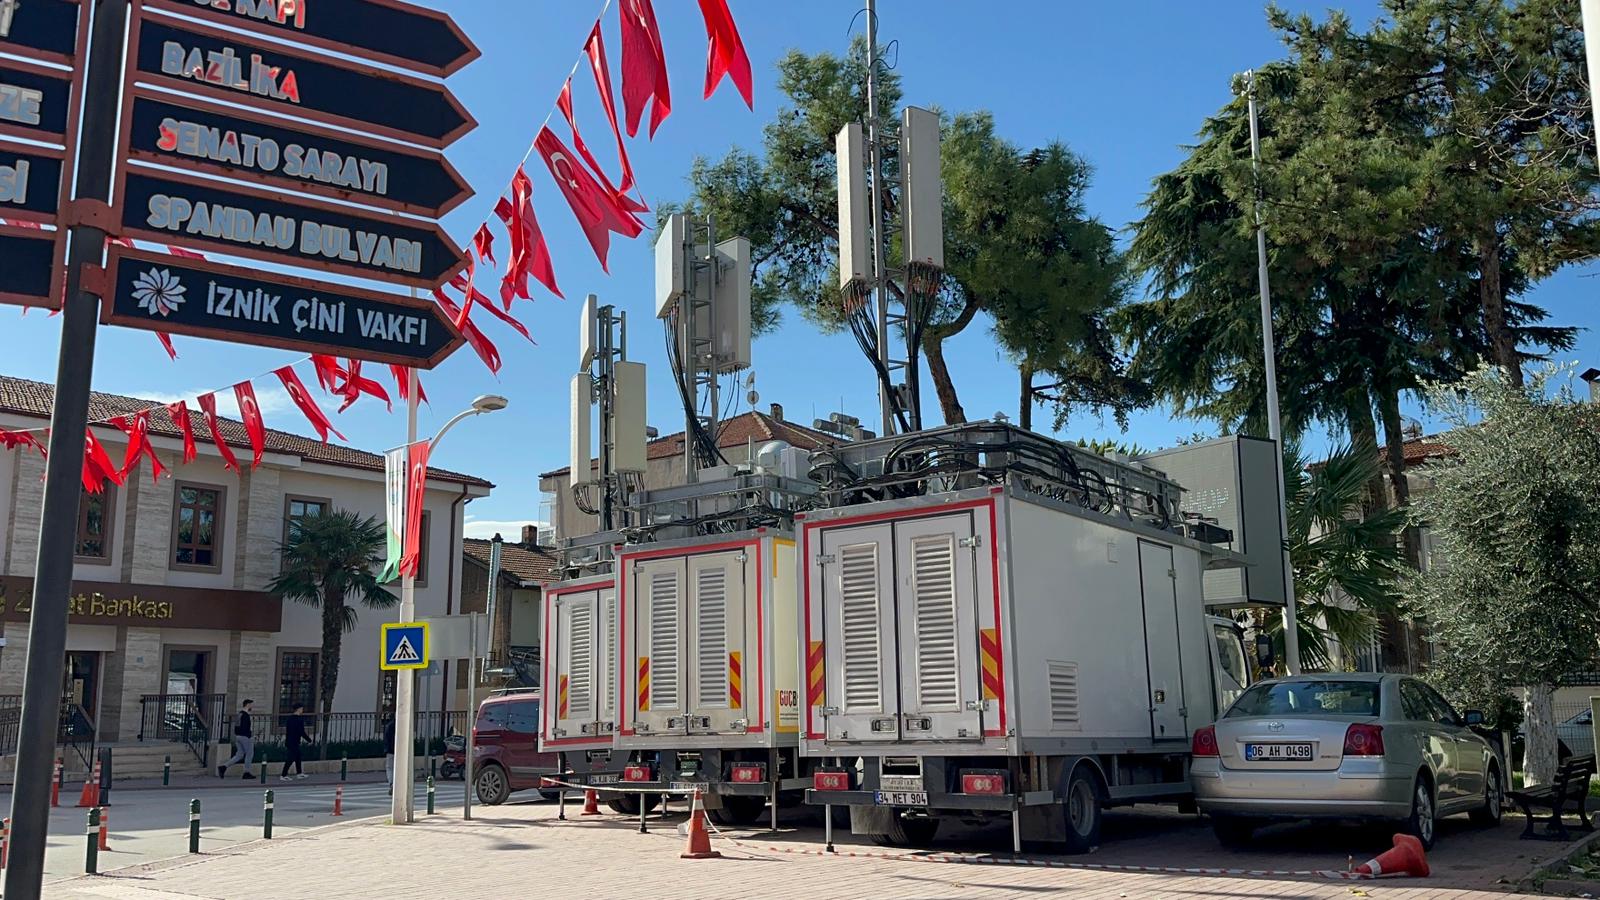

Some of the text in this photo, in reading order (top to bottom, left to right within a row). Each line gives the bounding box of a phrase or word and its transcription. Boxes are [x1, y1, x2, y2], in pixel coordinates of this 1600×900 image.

[161, 40, 301, 104] BAZİLİKA
[156, 117, 389, 195] SENATO SARAYI
[146, 193, 423, 273] SPANDAU BULVARI
[206, 280, 428, 346] İZNİK ÇİNİ VAKFI
[90, 592, 173, 619] Bankası
[1252, 745, 1263, 757] 06
[1268, 745, 1280, 757] AH
[1285, 745, 1310, 757] 0498
[879, 793, 926, 804] 34 MET 904
